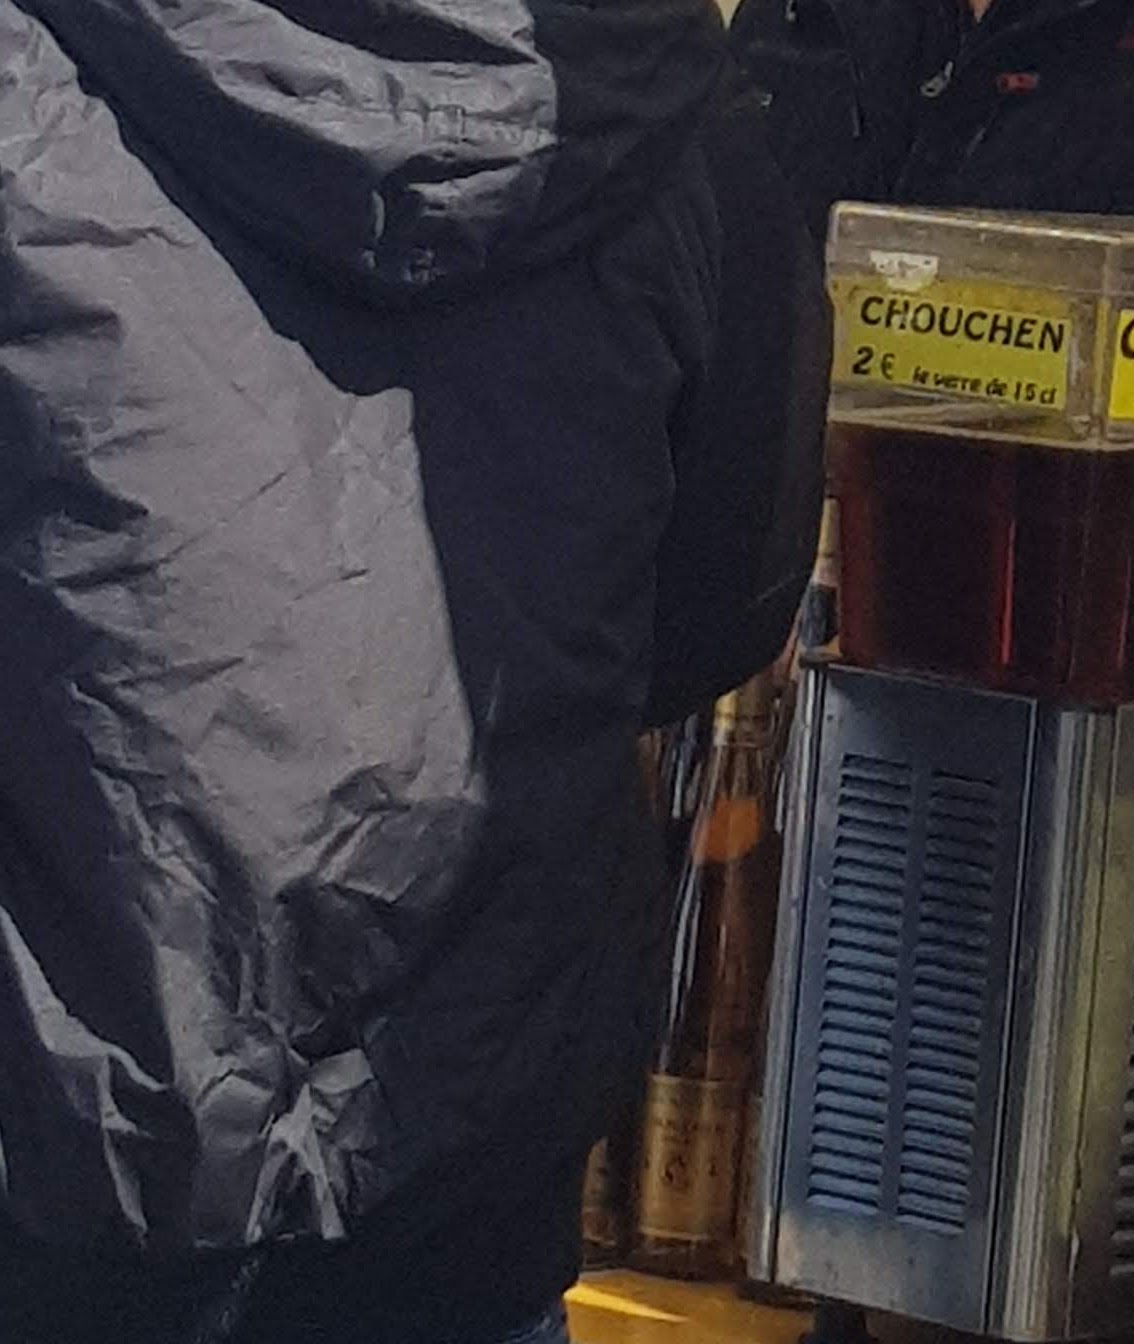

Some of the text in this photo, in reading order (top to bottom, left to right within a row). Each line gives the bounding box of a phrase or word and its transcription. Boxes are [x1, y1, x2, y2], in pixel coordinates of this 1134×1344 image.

[860, 296, 1065, 353] CHOUCHEN
[852, 345, 874, 375] 2
[881, 352, 896, 381] €
[933, 373, 982, 393] verre
[986, 377, 1008, 397] de
[1014, 381, 1037, 402] 15
